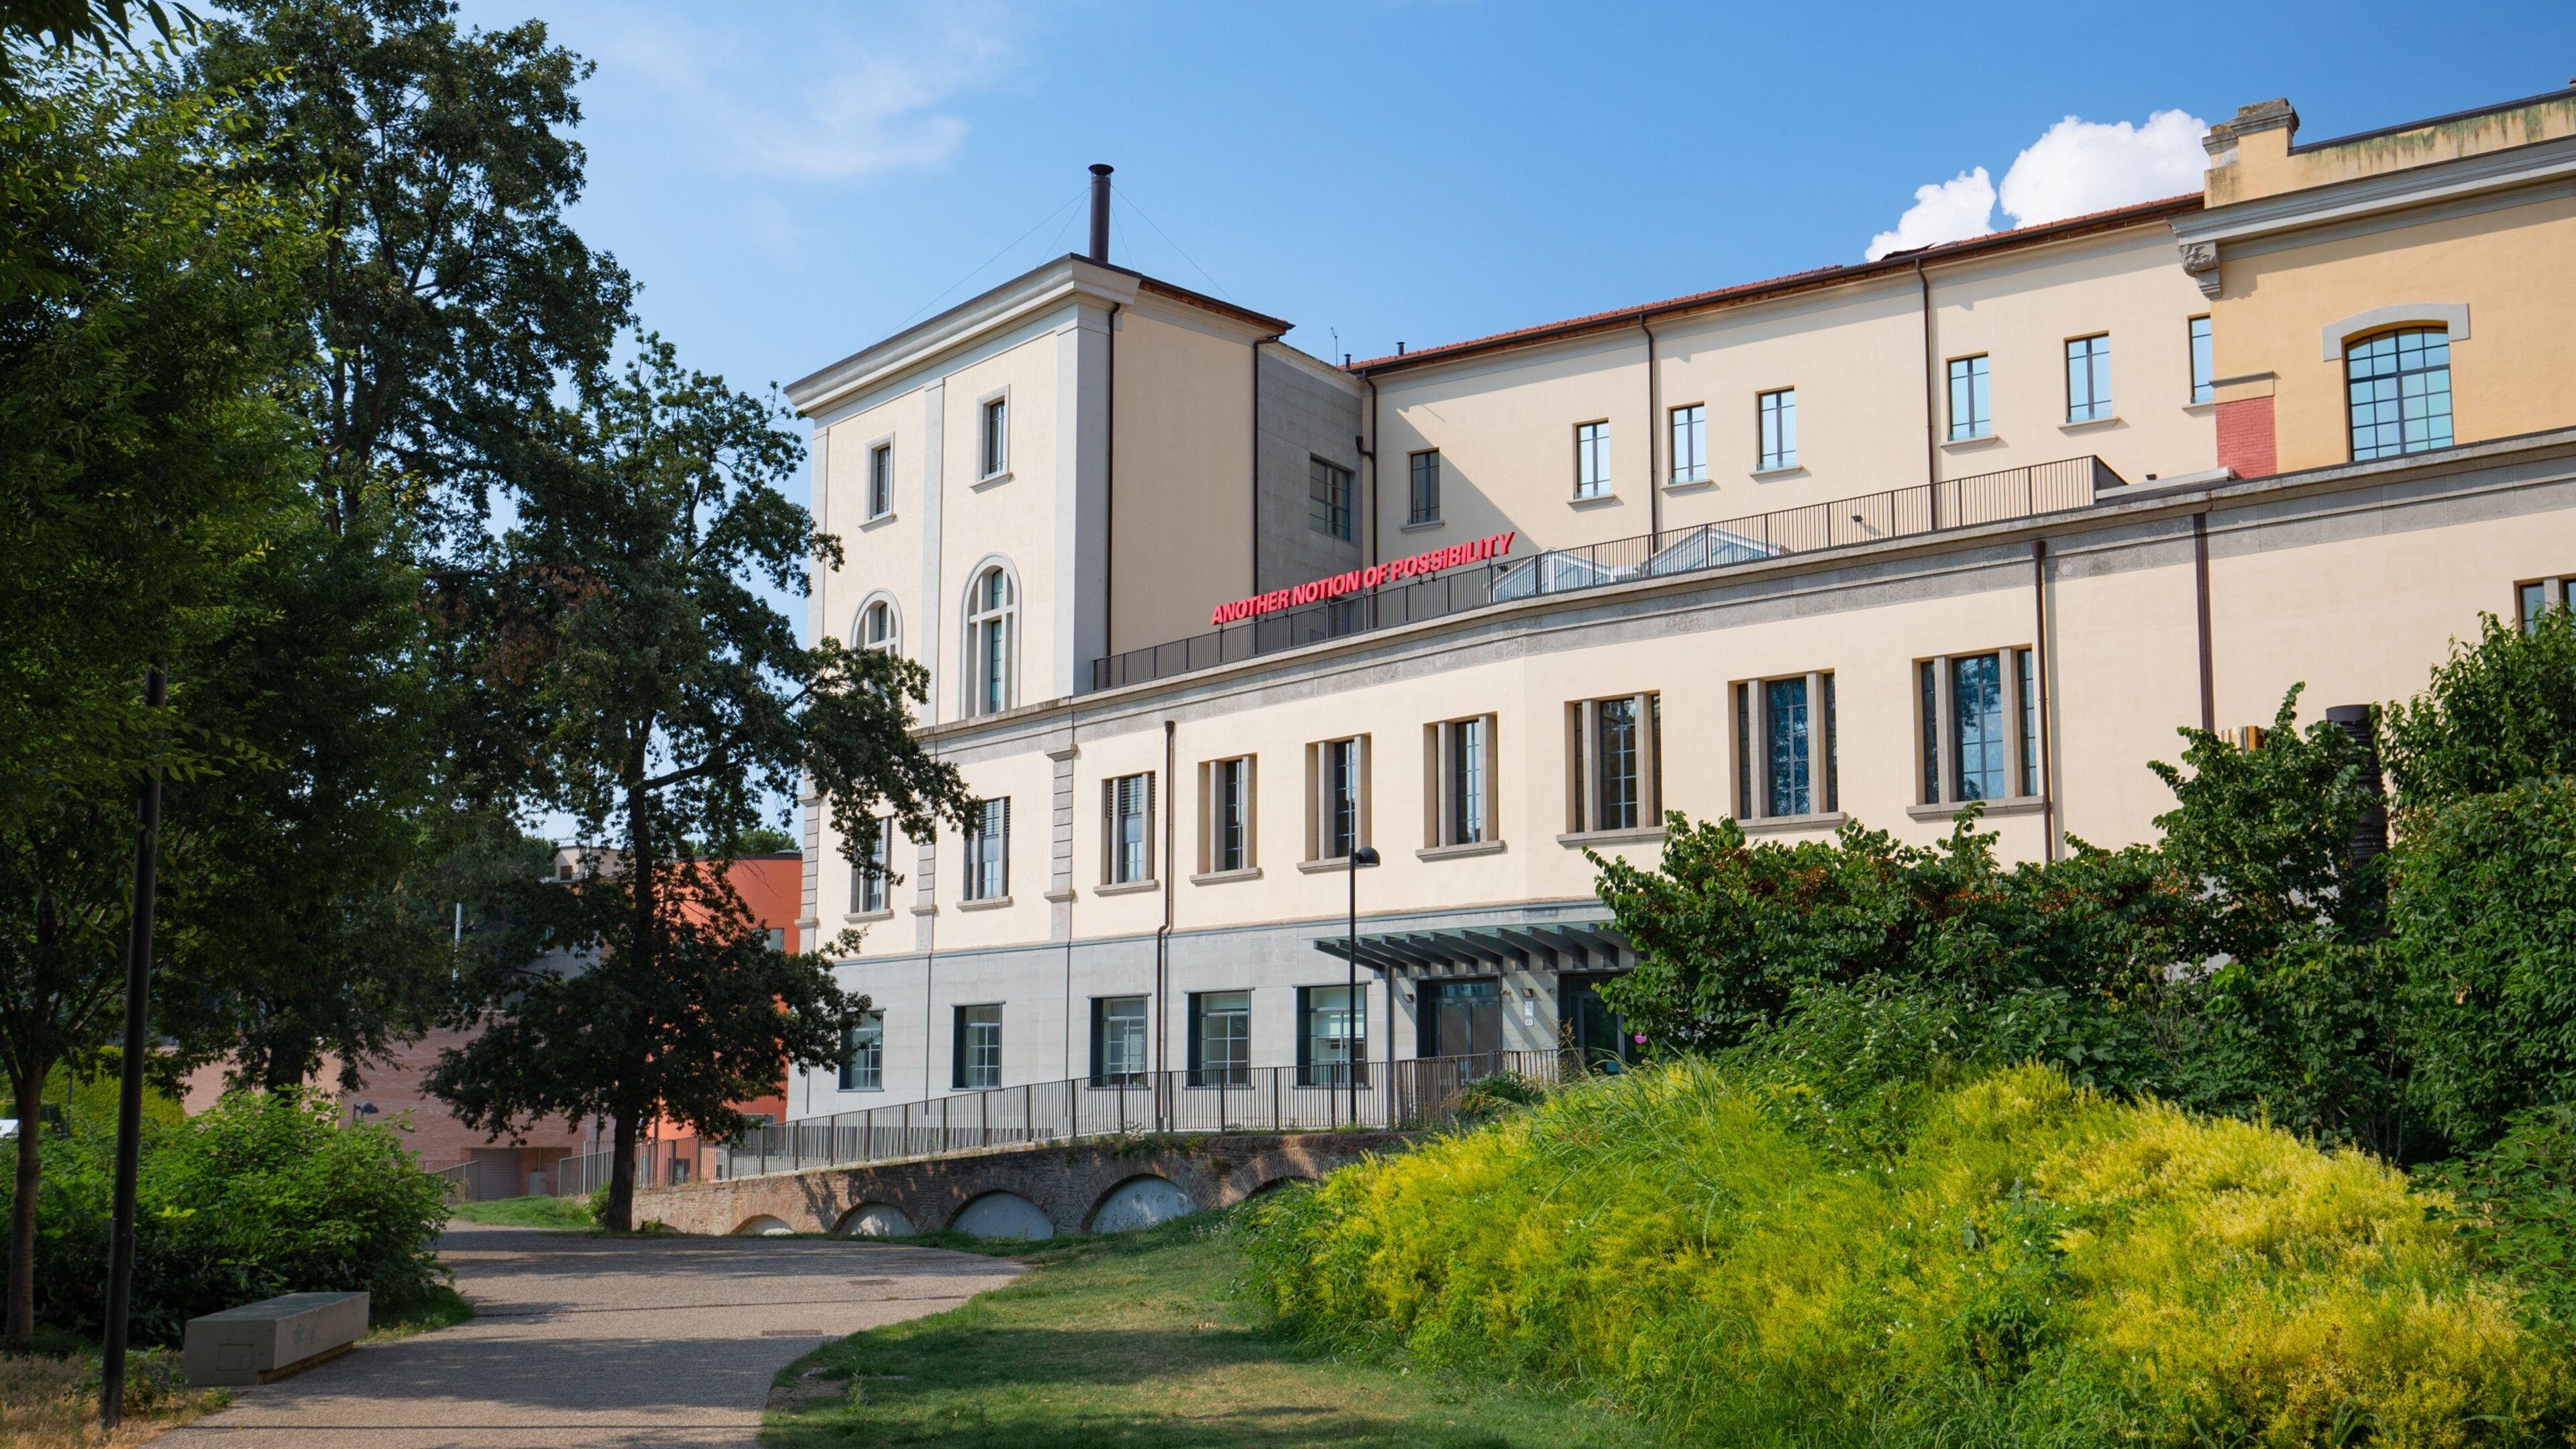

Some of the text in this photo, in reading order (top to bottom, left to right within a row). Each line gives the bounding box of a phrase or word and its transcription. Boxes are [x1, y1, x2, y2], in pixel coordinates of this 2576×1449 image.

[1211, 532, 1514, 625] ANOTHER NOTION OF POSSIBILITY
